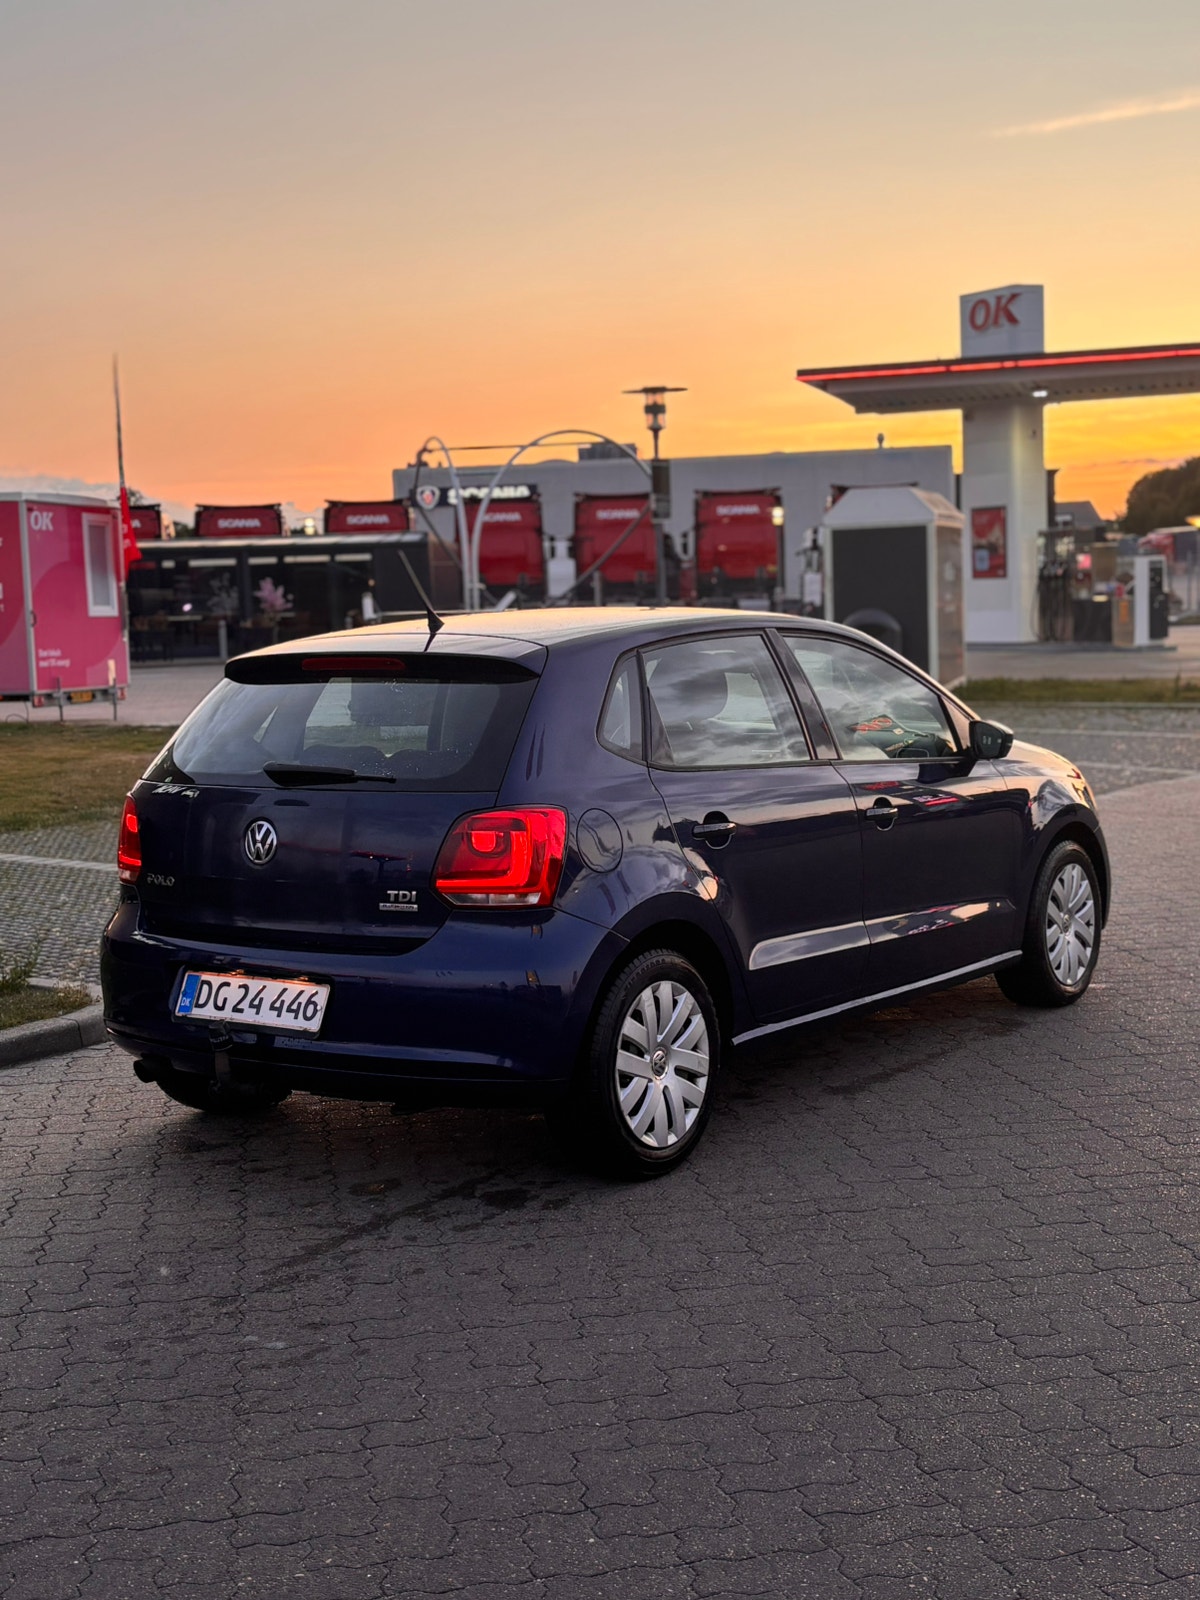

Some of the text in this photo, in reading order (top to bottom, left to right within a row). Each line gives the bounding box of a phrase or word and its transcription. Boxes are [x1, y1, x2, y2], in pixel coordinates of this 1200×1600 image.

[968, 292, 1022, 332] OK
[716, 505, 760, 516] SCANIA
[30, 511, 54, 531] OK
[217, 518, 261, 529] SCANIA
[346, 514, 390, 525] SCANIA
[146, 872, 175, 887] POLO
[387, 890, 417, 902] TDI
[180, 996, 191, 1007] DK
[194, 979, 319, 1022] DG 24 446
